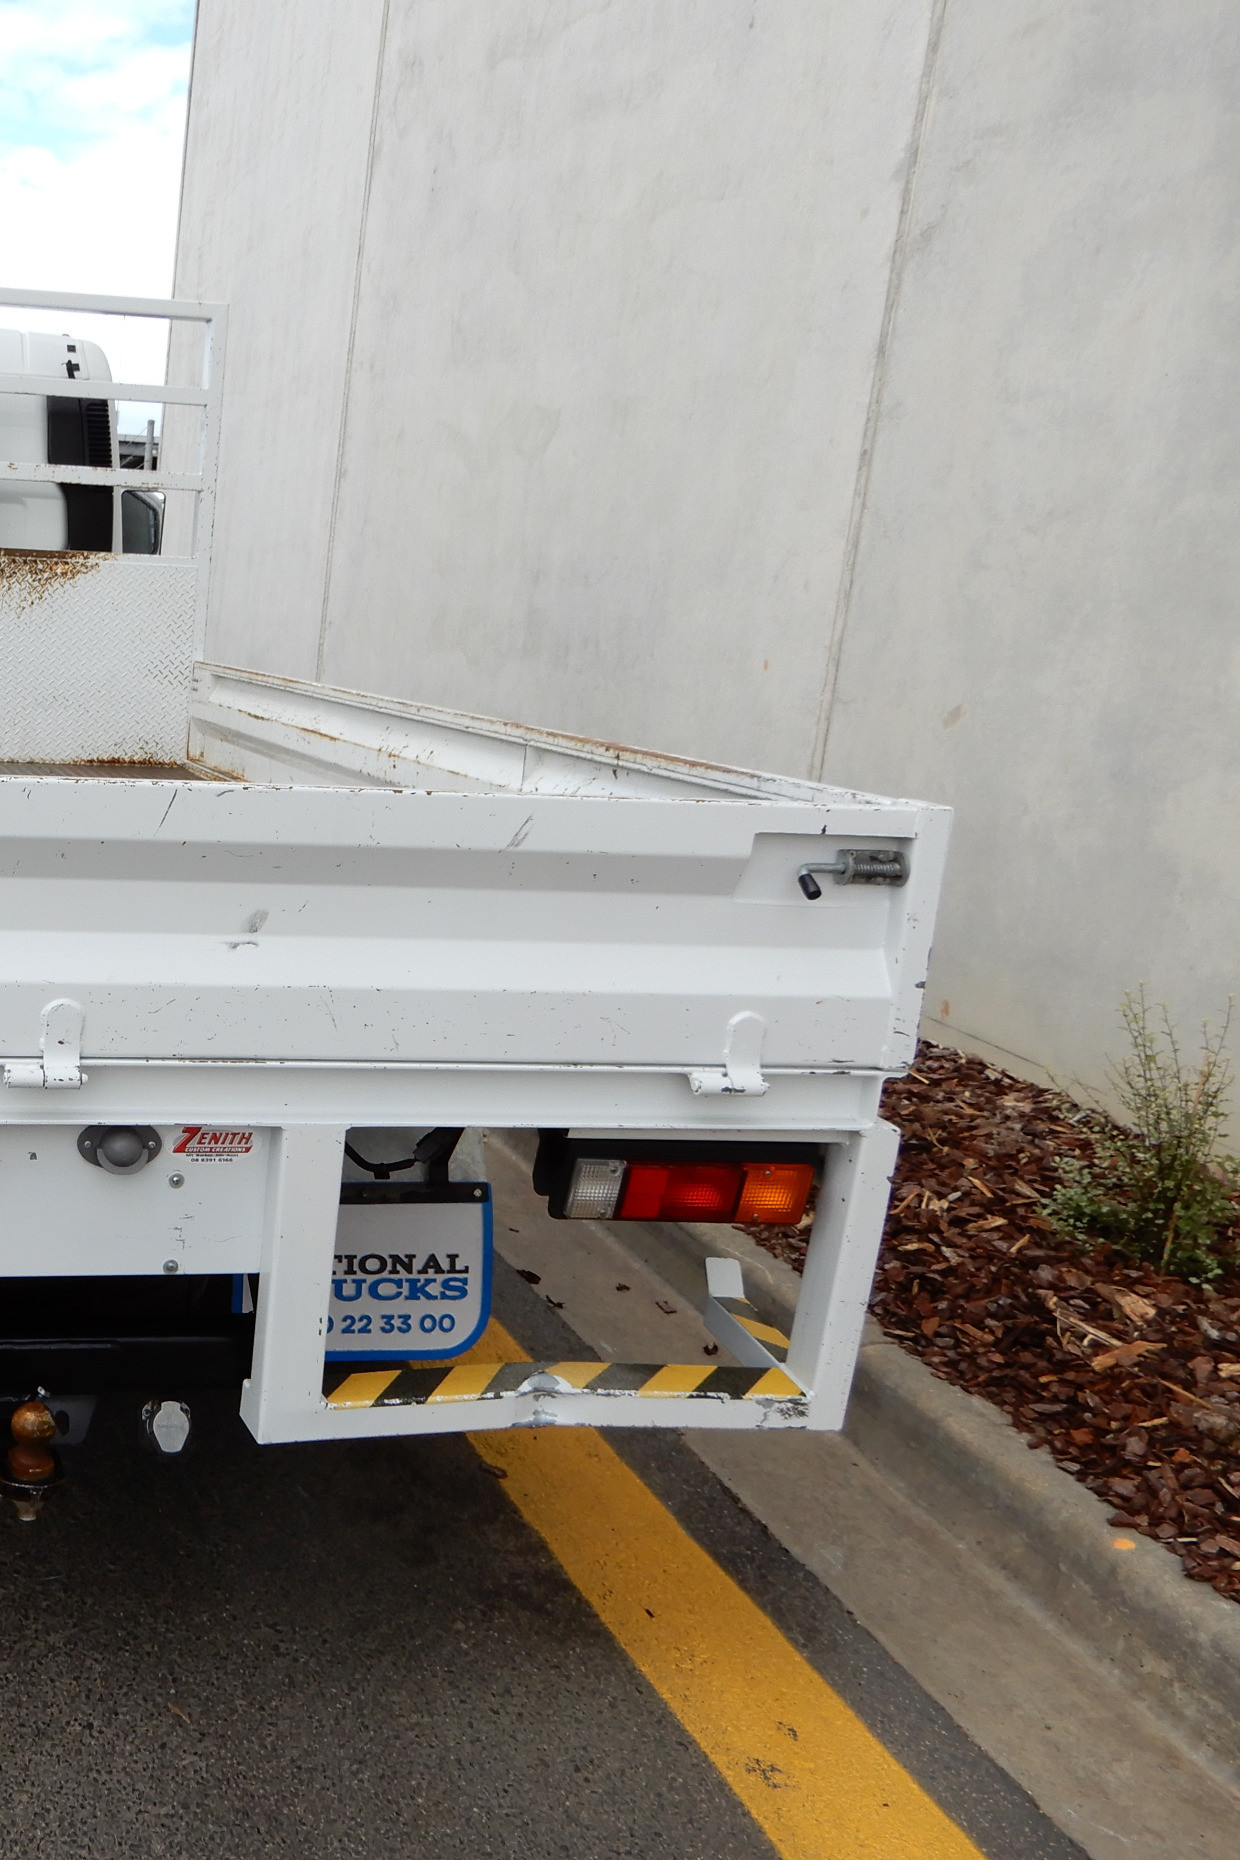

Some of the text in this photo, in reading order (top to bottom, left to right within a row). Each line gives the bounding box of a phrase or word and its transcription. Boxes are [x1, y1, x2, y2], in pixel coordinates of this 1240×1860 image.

[172, 1126, 254, 1153] ZENITH
[341, 1314, 372, 1334] 22
[379, 1313, 412, 1334] 33
[419, 1313, 455, 1333] 00
